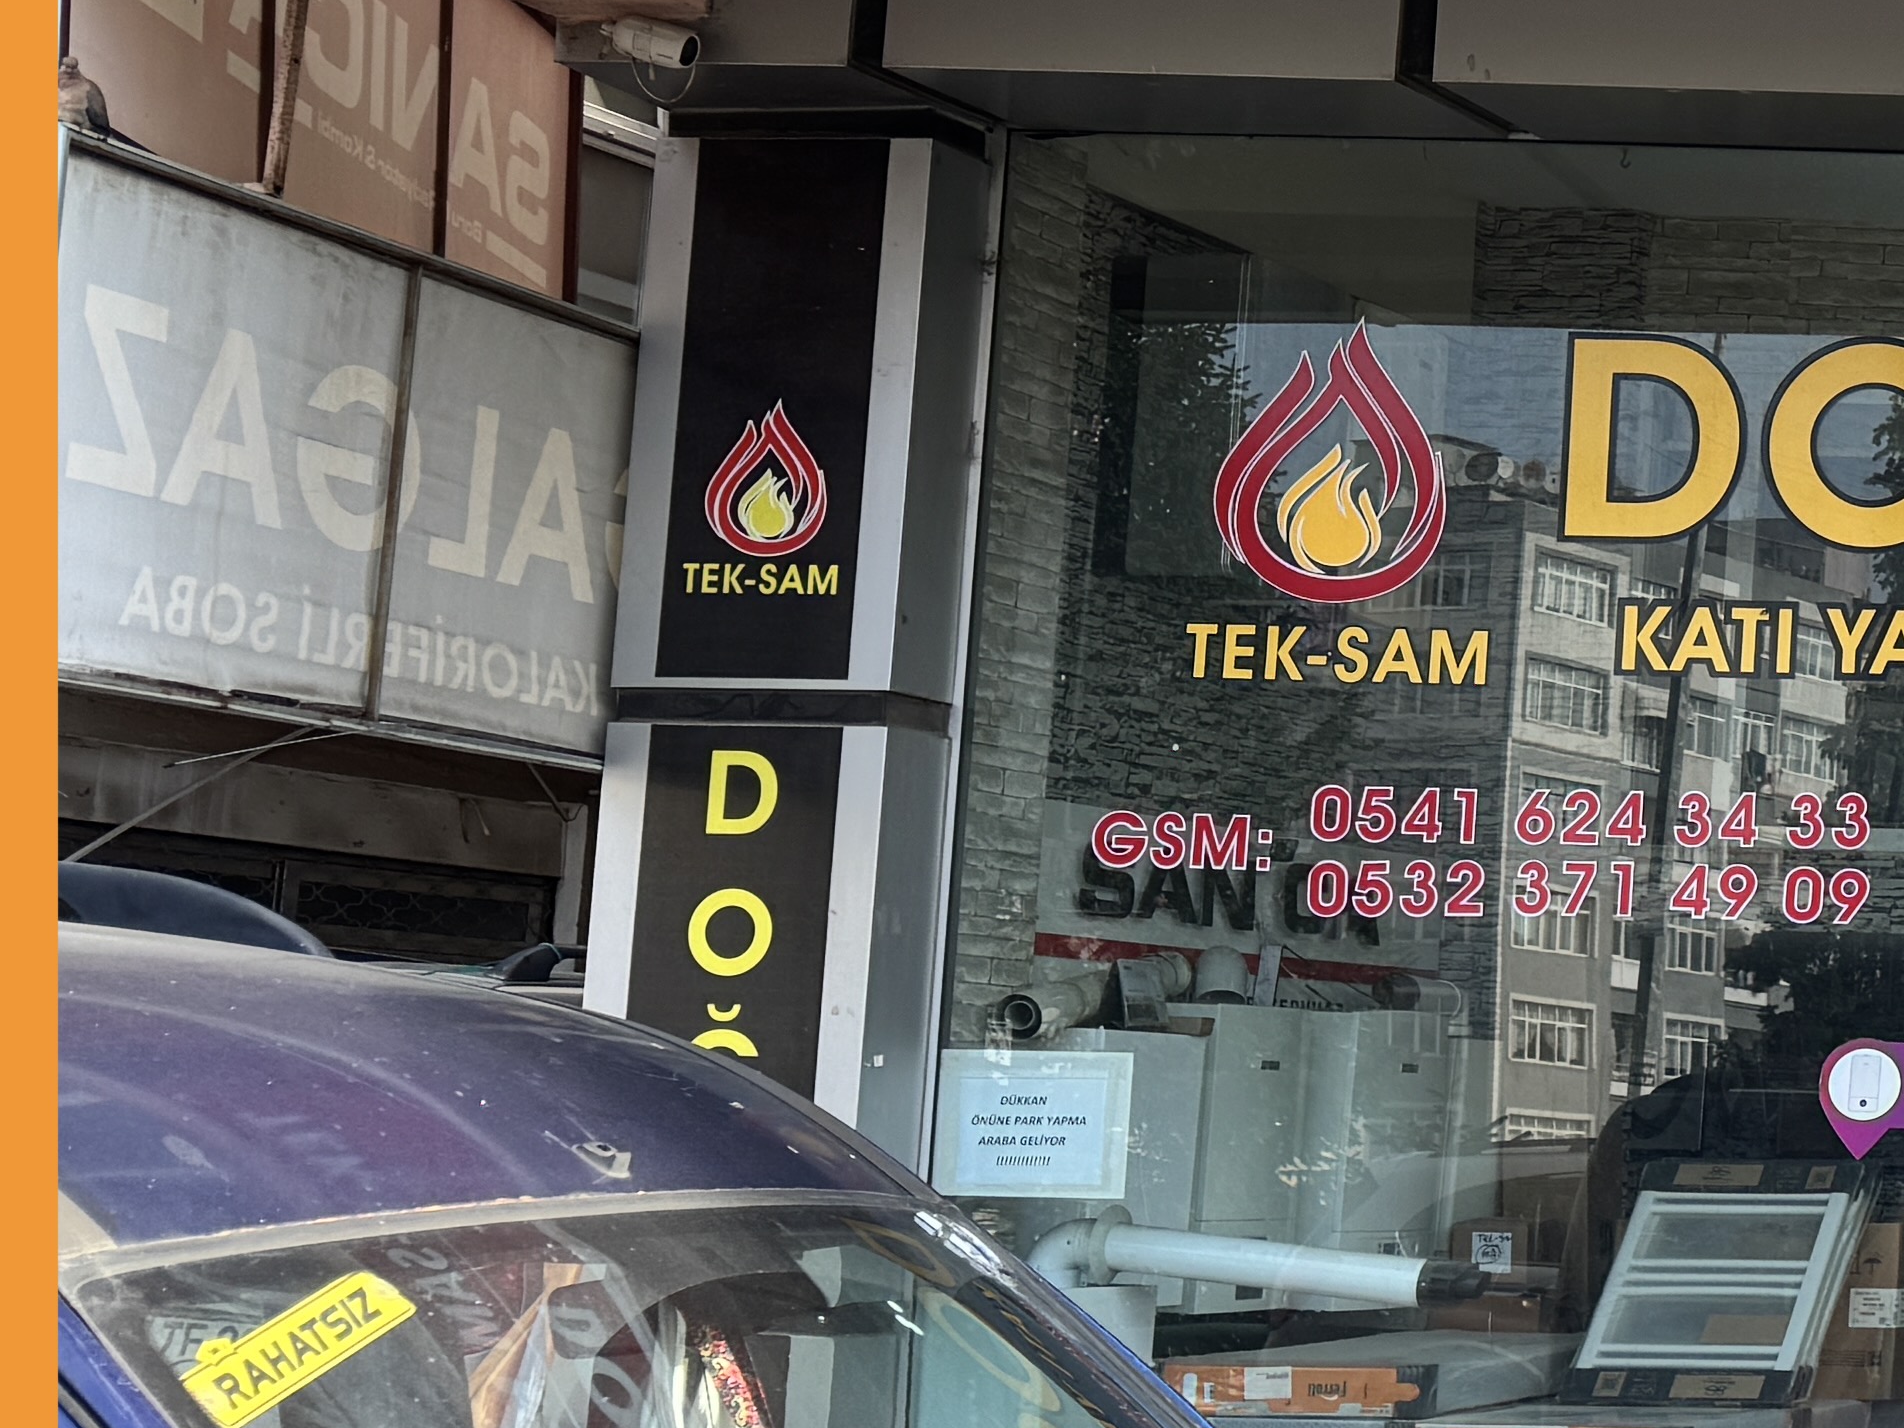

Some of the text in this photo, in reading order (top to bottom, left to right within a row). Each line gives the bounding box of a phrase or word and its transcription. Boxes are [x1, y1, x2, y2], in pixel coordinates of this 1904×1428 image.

[683, 562, 839, 597] TEK-SAM
[1185, 622, 1490, 686] TEK-SAM
[1616, 597, 1800, 678] KATI
[1091, 784, 1872, 872] GSM: 0541 624 34 33
[1304, 859, 1872, 926] 0532 371 49 09
[971, 1114, 1087, 1126] ÖNÜNE PARK YAPMA
[1000, 1094, 1048, 1106] DÜKKAN
[978, 1134, 1066, 1146] ARABA GELİYOR
[212, 1287, 382, 1410] RAHATSIZ
